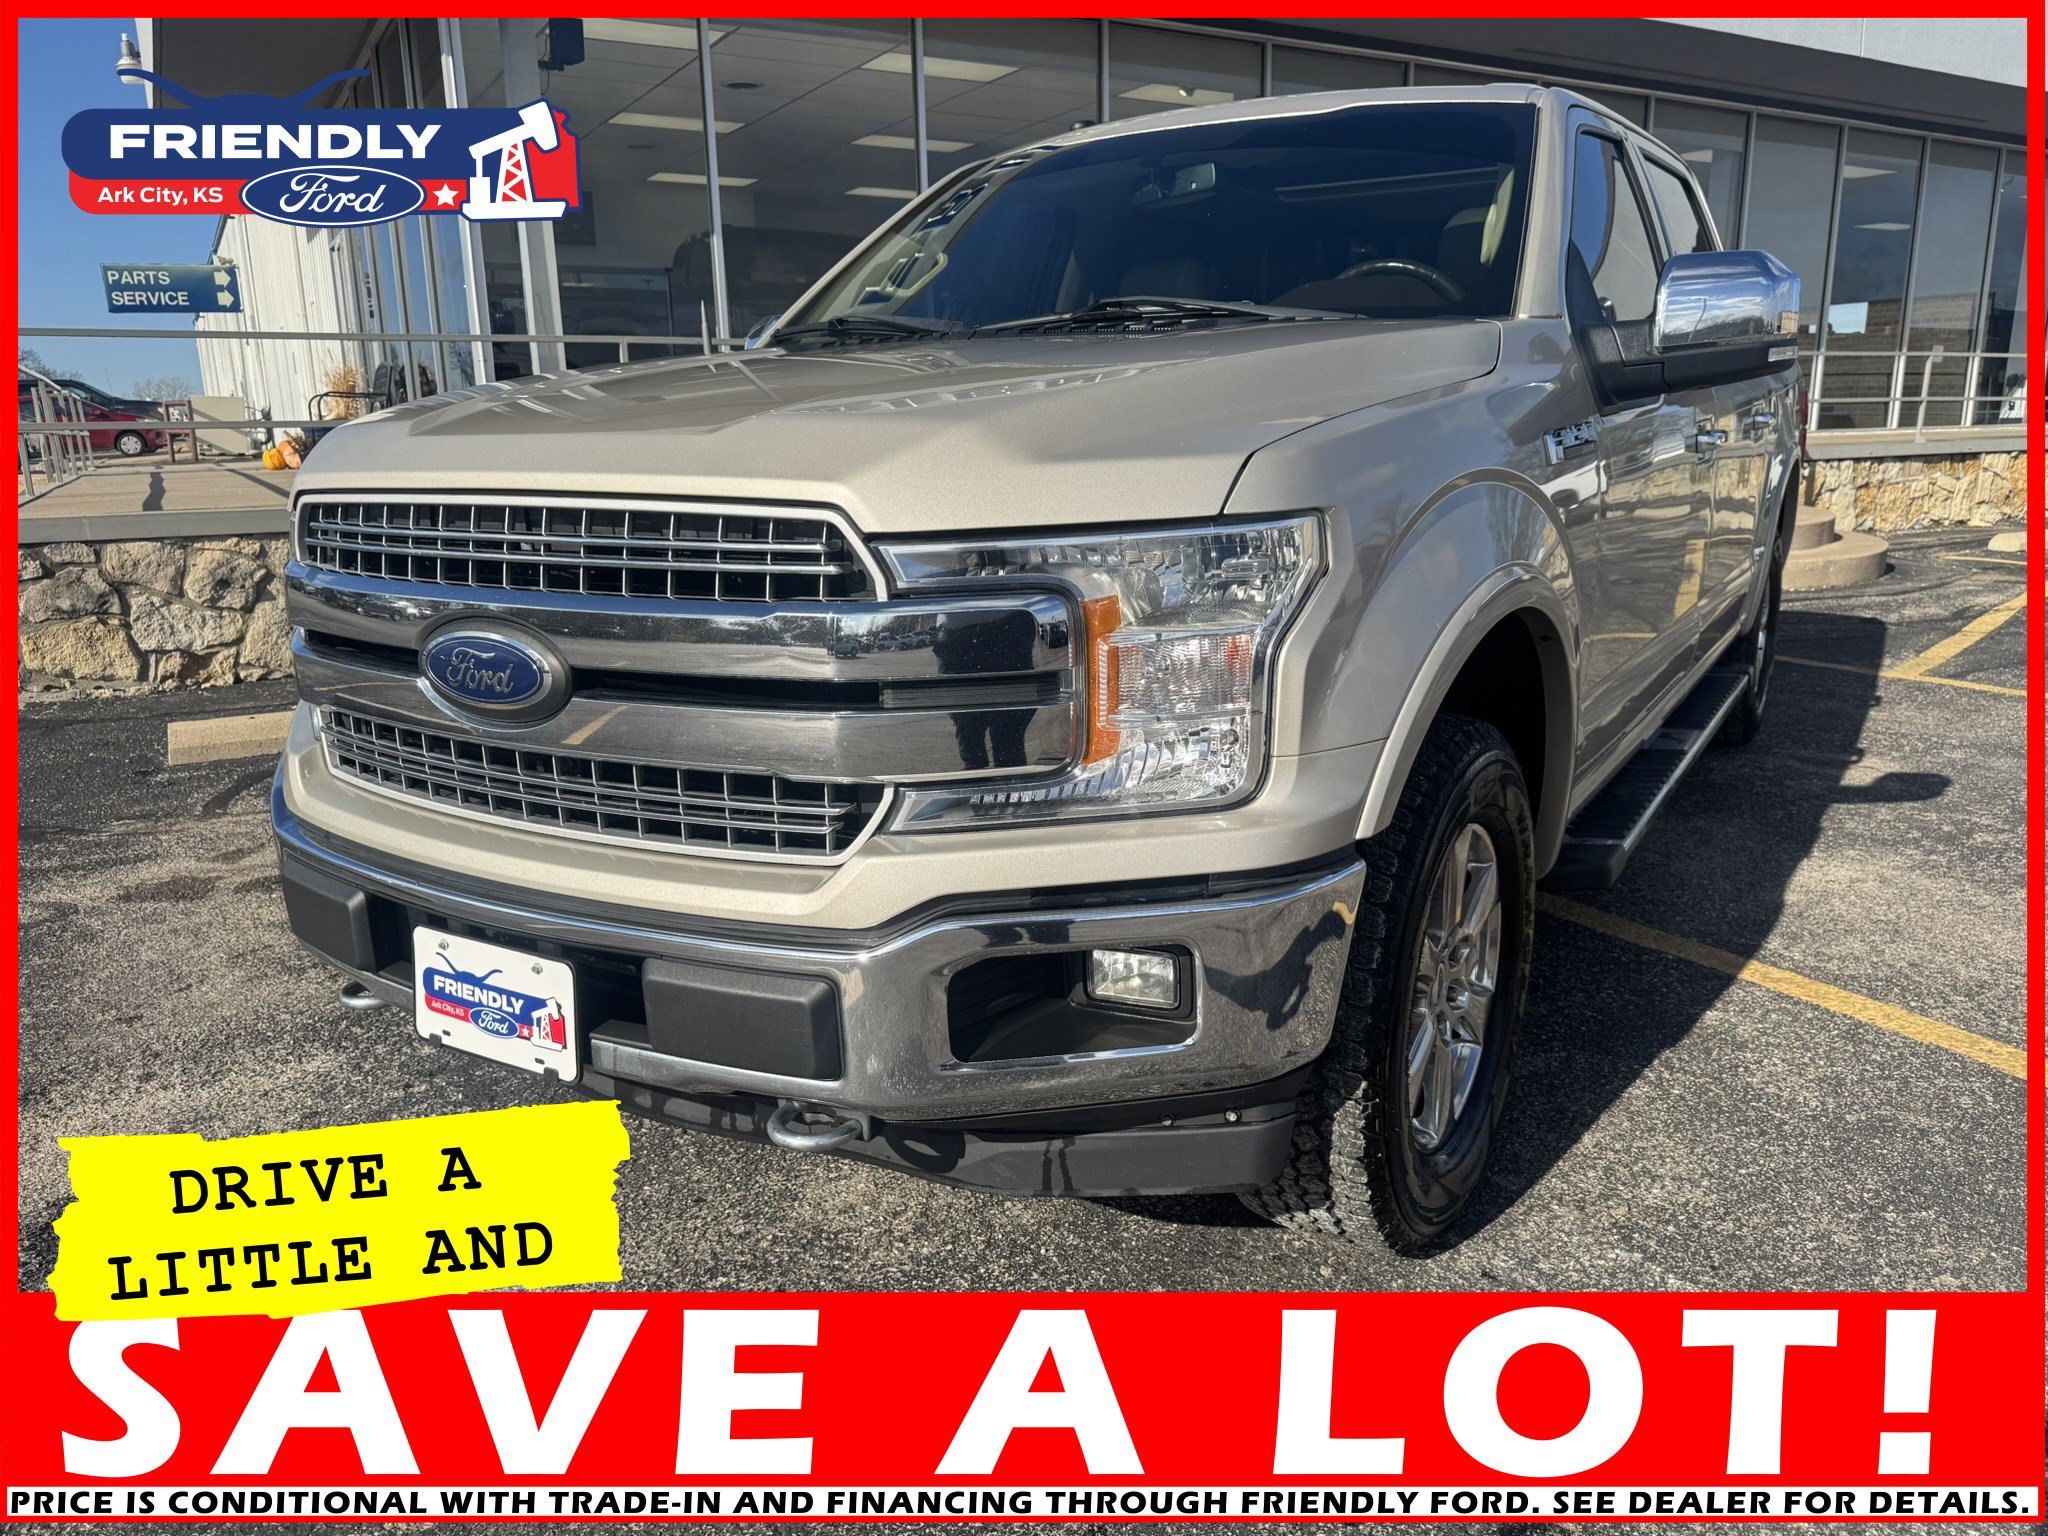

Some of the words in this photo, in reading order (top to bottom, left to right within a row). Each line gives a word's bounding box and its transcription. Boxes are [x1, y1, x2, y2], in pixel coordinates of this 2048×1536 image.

[107, 270, 171, 285] PARTS
[111, 291, 190, 306] SERVICE
[446, 647, 514, 694] Ford
[431, 999, 442, 1009] Ark
[433, 974, 525, 1015] FRIENDLY
[477, 1009, 510, 1034] Ford
